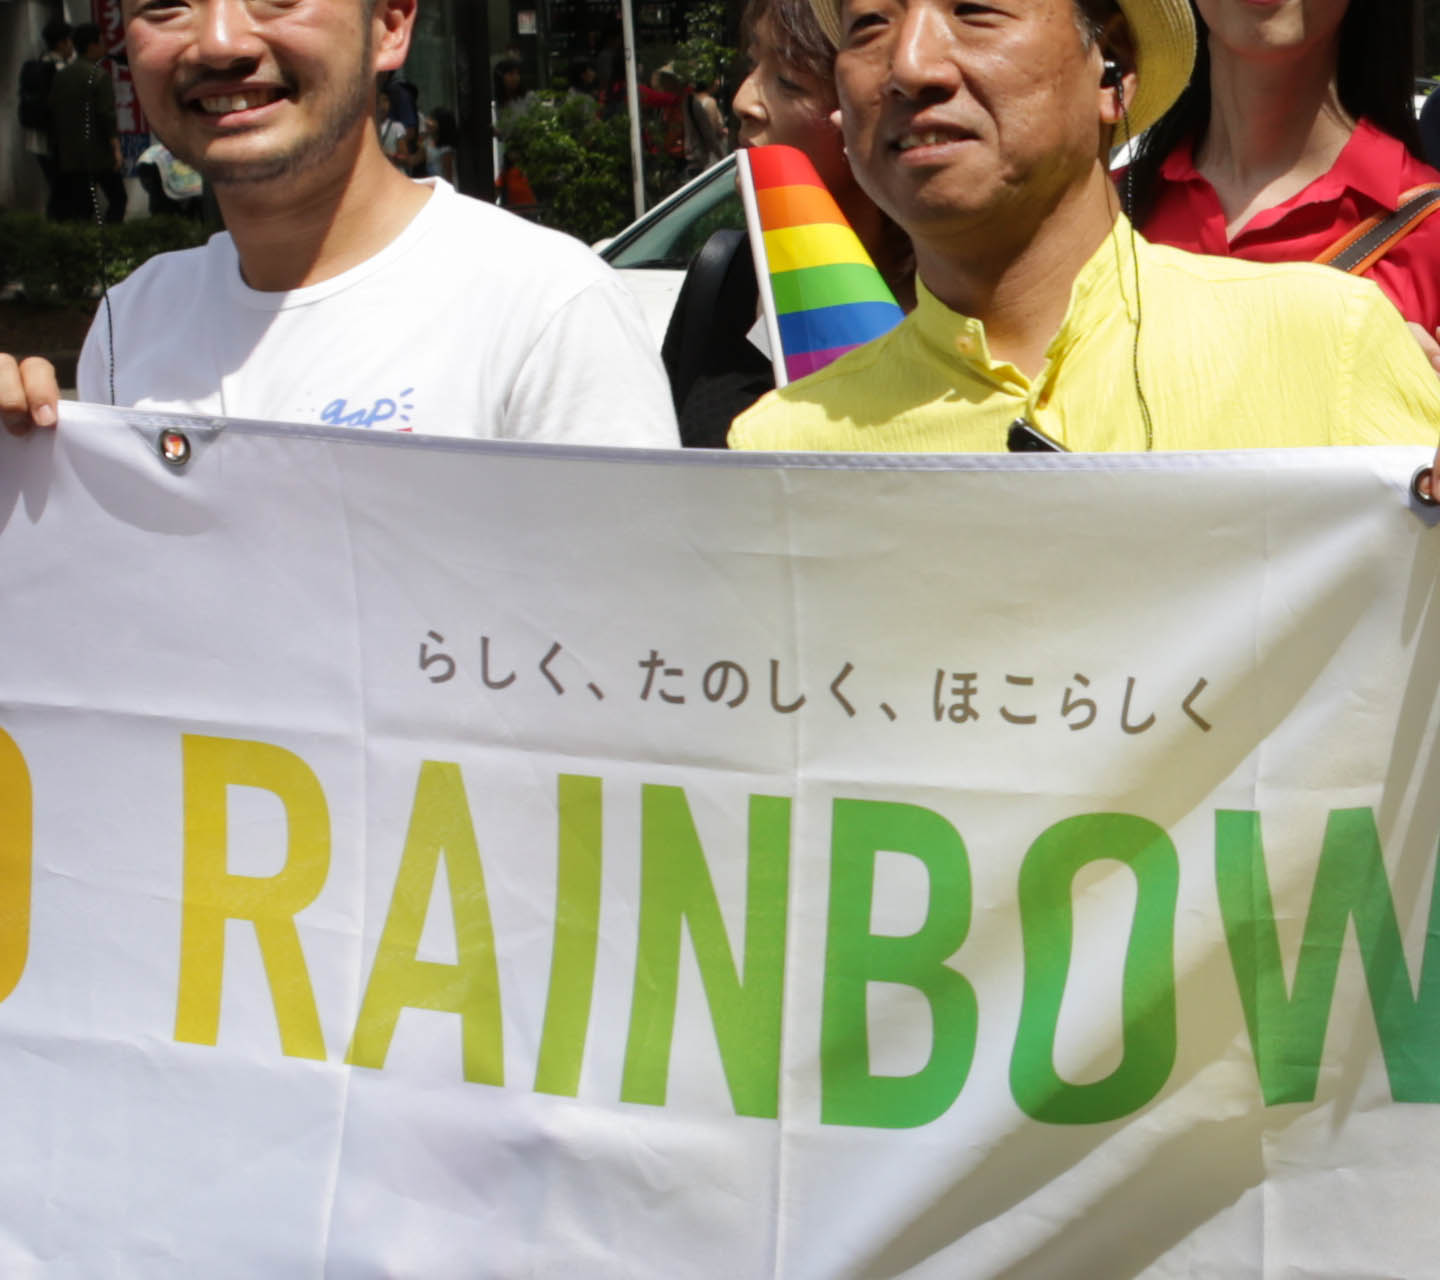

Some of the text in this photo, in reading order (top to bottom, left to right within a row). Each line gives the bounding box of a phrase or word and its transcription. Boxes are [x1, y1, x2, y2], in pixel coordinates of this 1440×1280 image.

[416, 629, 1215, 735] らしく、たのしく、ほこらしく
